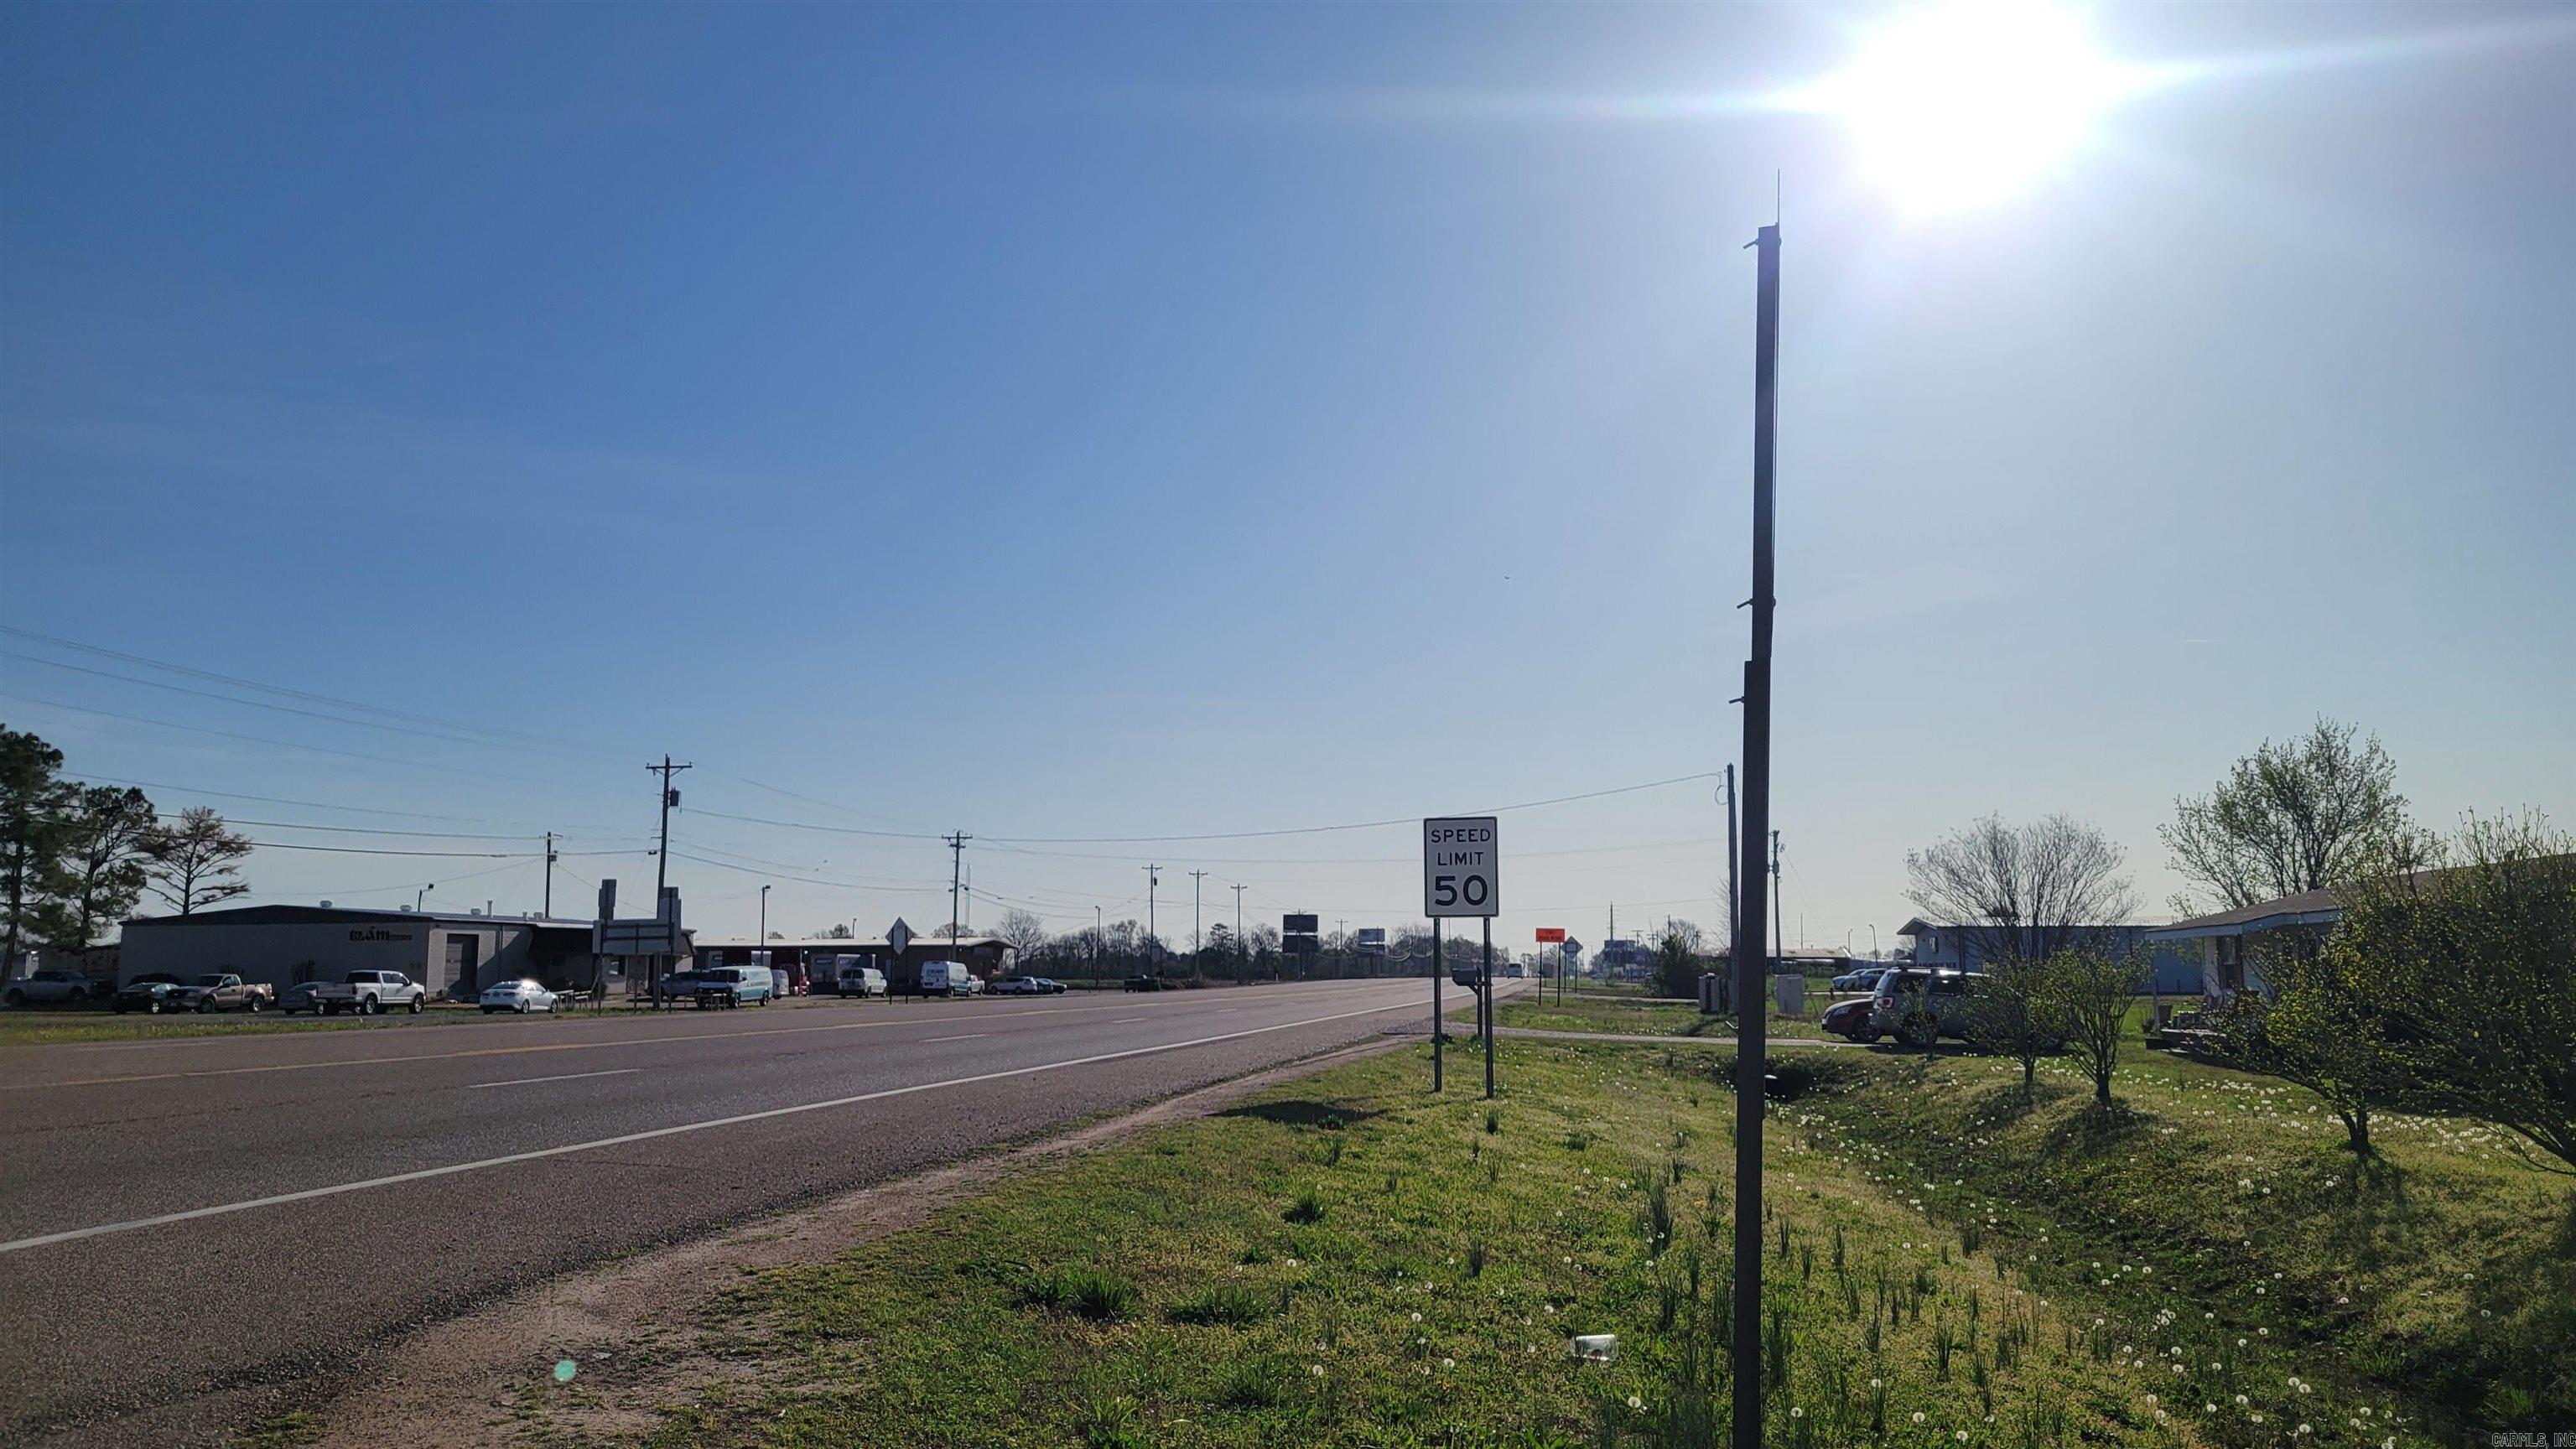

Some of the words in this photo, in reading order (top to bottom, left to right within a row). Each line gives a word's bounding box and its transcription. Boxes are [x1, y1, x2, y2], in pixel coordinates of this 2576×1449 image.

[1431, 828, 1491, 844] SPEED
[1437, 851, 1484, 866] LIMIT
[1435, 875, 1488, 906] 50
